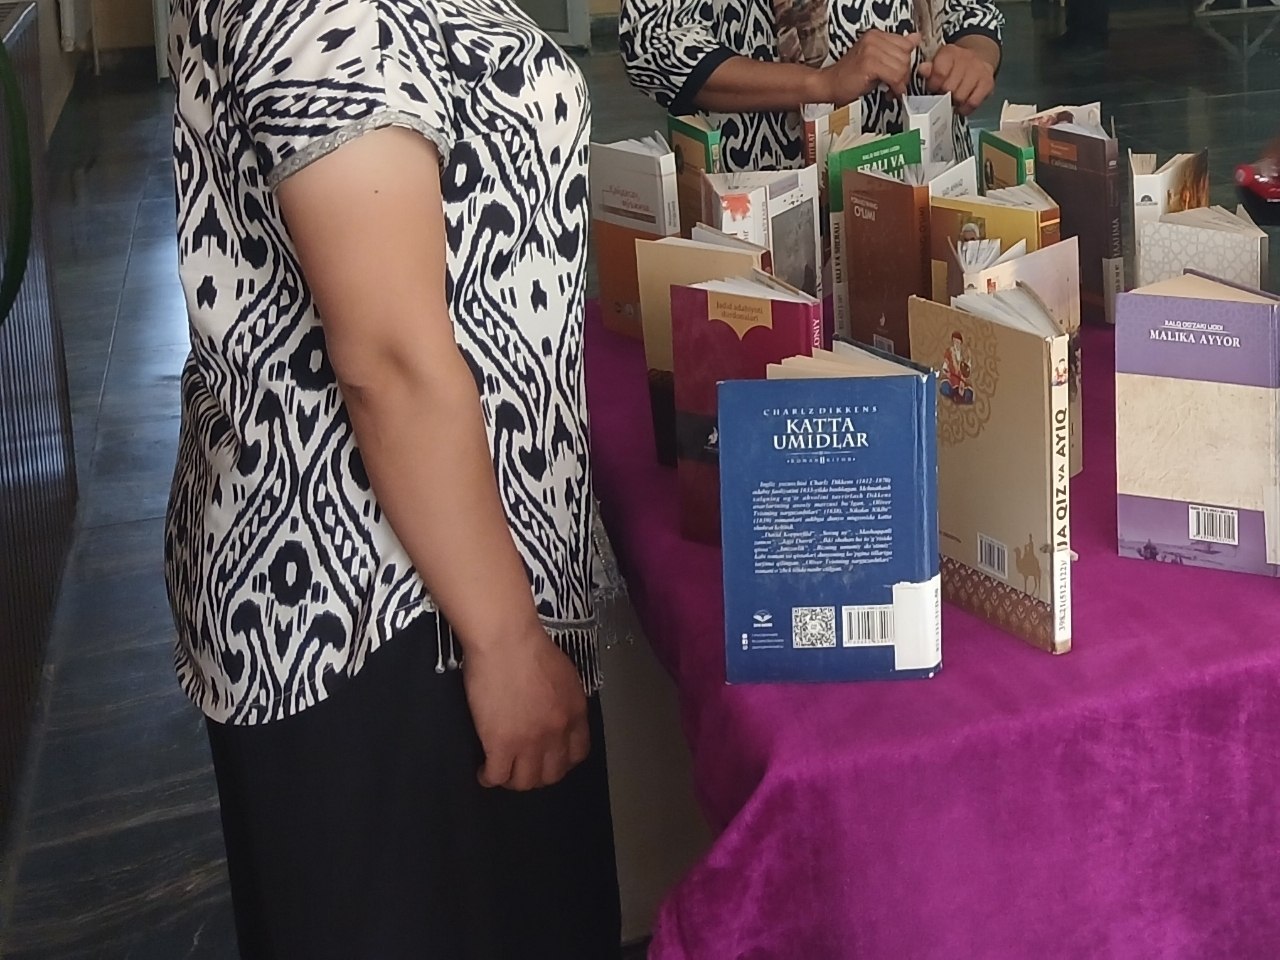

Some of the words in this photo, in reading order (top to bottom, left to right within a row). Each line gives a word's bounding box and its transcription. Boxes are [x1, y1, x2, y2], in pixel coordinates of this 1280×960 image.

[1149, 329, 1195, 344] MALIKA
[1199, 334, 1241, 347] AYYOR
[819, 405, 878, 415] DIKKENS
[786, 417, 855, 434] KATTA
[1055, 407, 1068, 458] AYIQ
[773, 432, 869, 450] UMIDLAR
[1057, 463, 1066, 483] VA
[1056, 484, 1068, 521] QIZ
